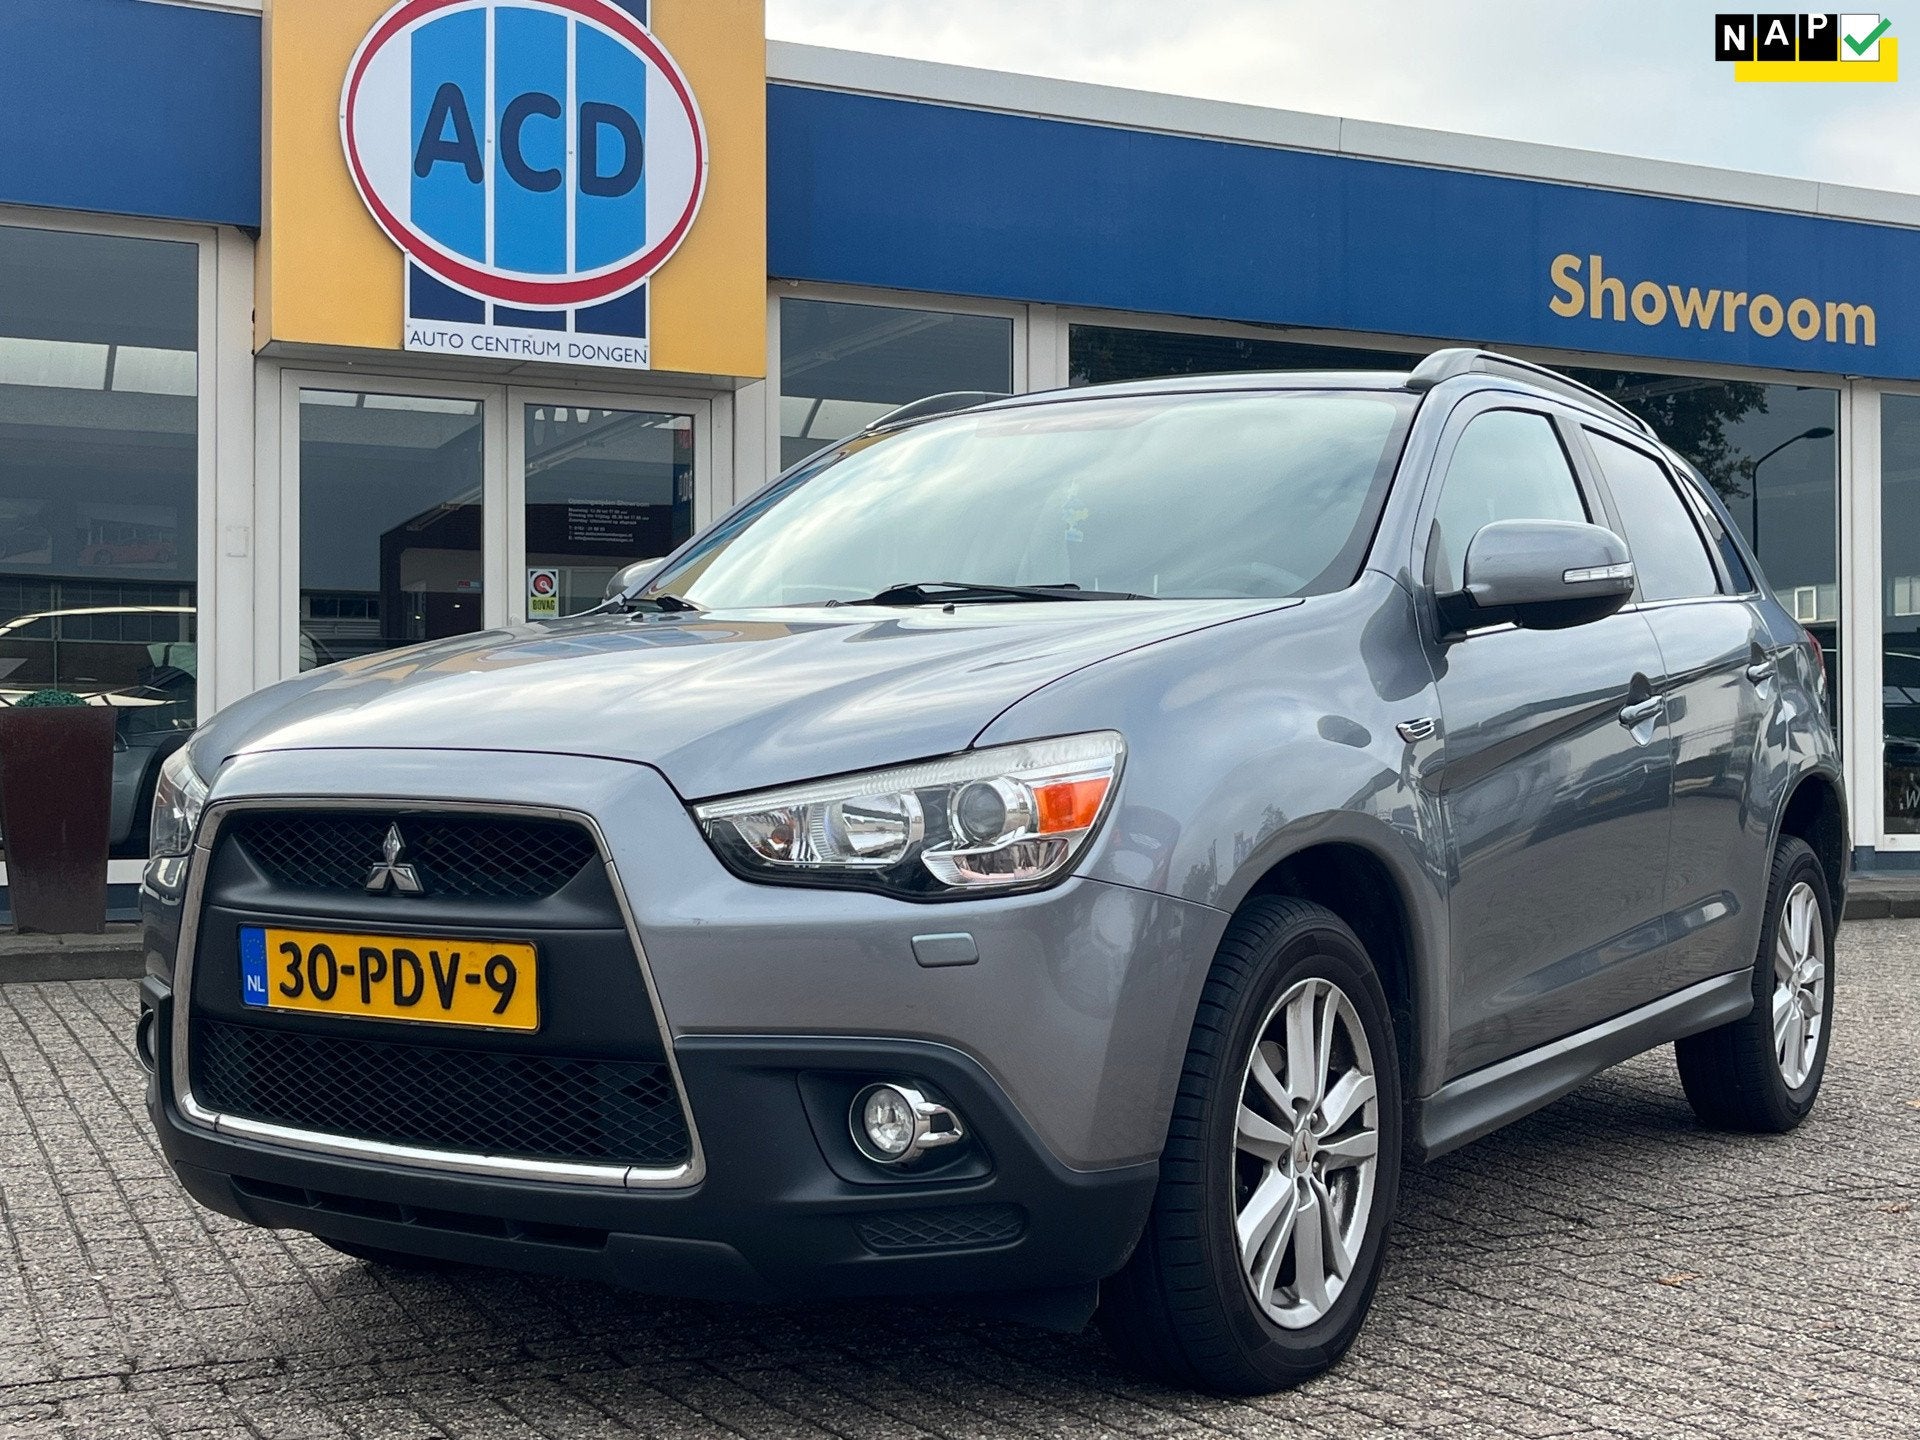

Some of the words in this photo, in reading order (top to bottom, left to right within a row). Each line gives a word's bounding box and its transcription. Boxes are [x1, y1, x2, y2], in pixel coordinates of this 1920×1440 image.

[414, 82, 644, 198] ACD
[1548, 253, 1876, 347] Showroom
[409, 330, 464, 349] AUTO
[471, 335, 561, 357] CENTRUM
[568, 343, 648, 364] DONGEN
[247, 975, 265, 992] NL
[279, 941, 517, 1014] 30-PDV-9
